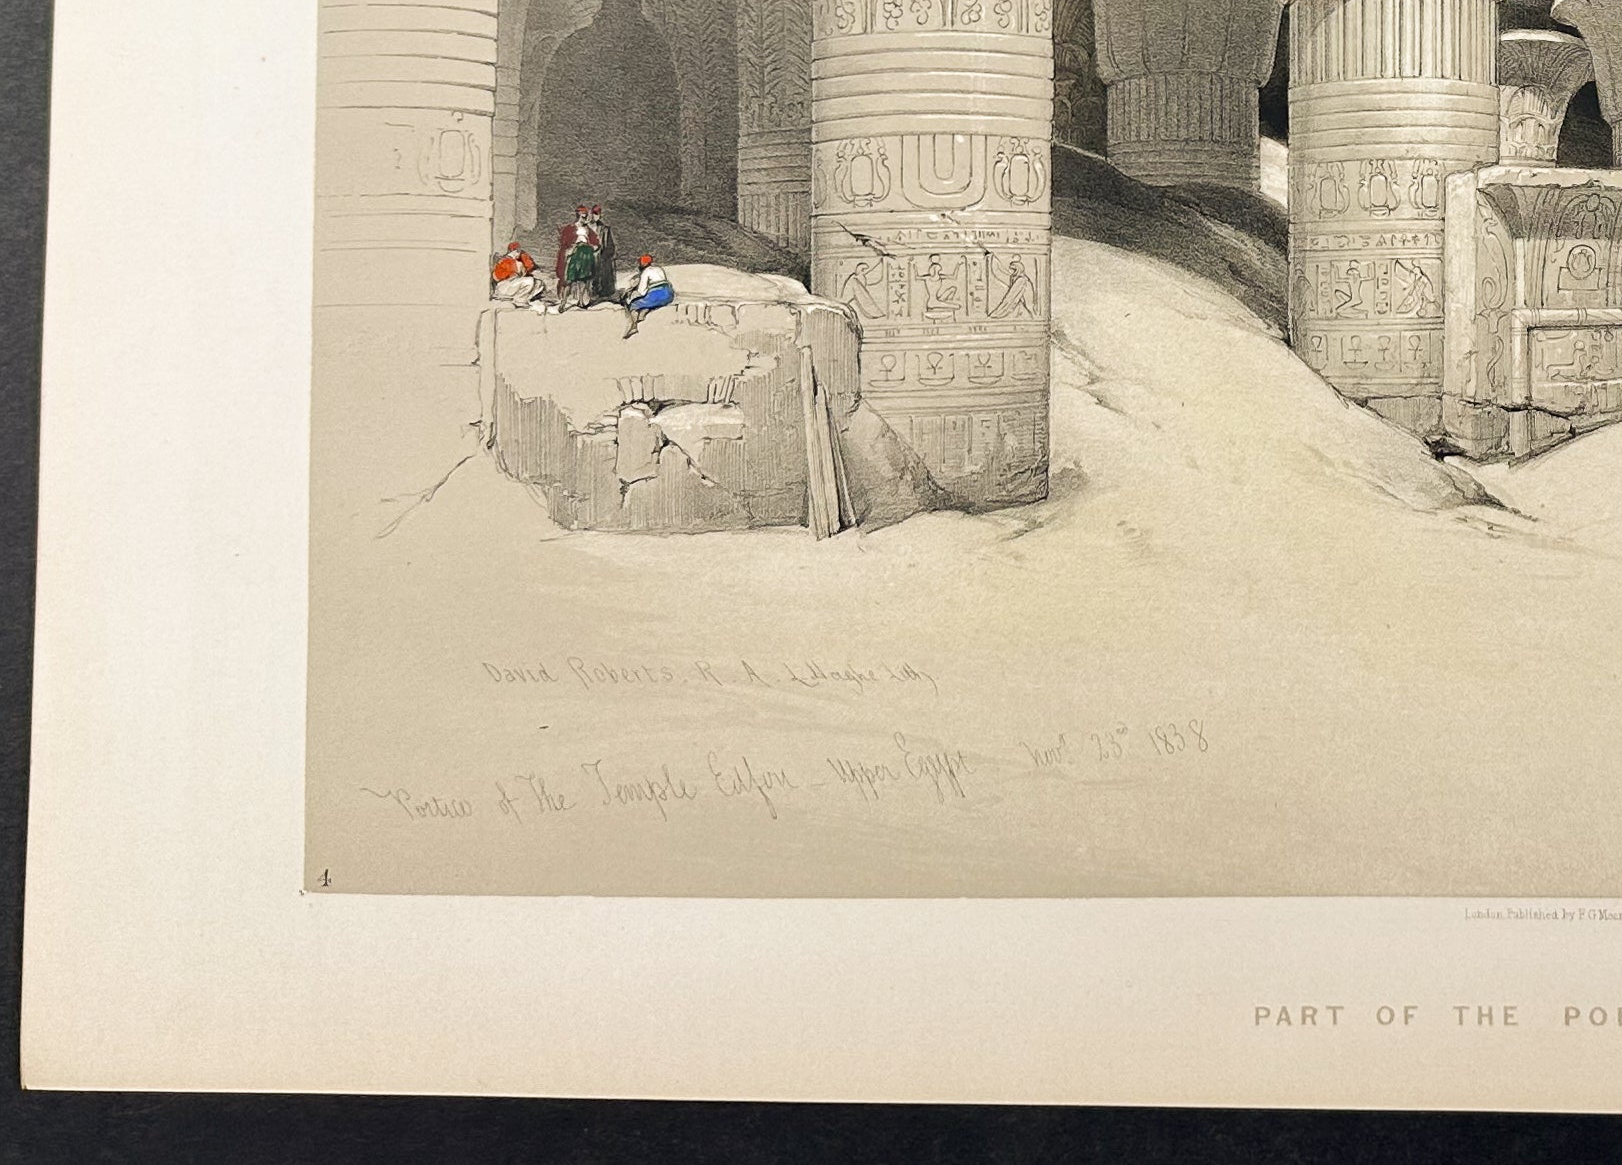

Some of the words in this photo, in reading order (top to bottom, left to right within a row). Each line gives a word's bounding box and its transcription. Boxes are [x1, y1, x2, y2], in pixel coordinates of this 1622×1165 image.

[481, 661, 558, 684] David
[494, 781, 523, 824] of
[581, 758, 697, 822] Temple
[826, 757, 900, 801] Upper
[892, 731, 977, 805] Egypt
[1148, 718, 1209, 754] 1838
[1507, 907, 1559, 920] Published
[1561, 907, 1576, 922] by
[1254, 1005, 1345, 1027] PART
[1375, 1005, 1419, 1026] OF
[1452, 1005, 1519, 1027] THE
